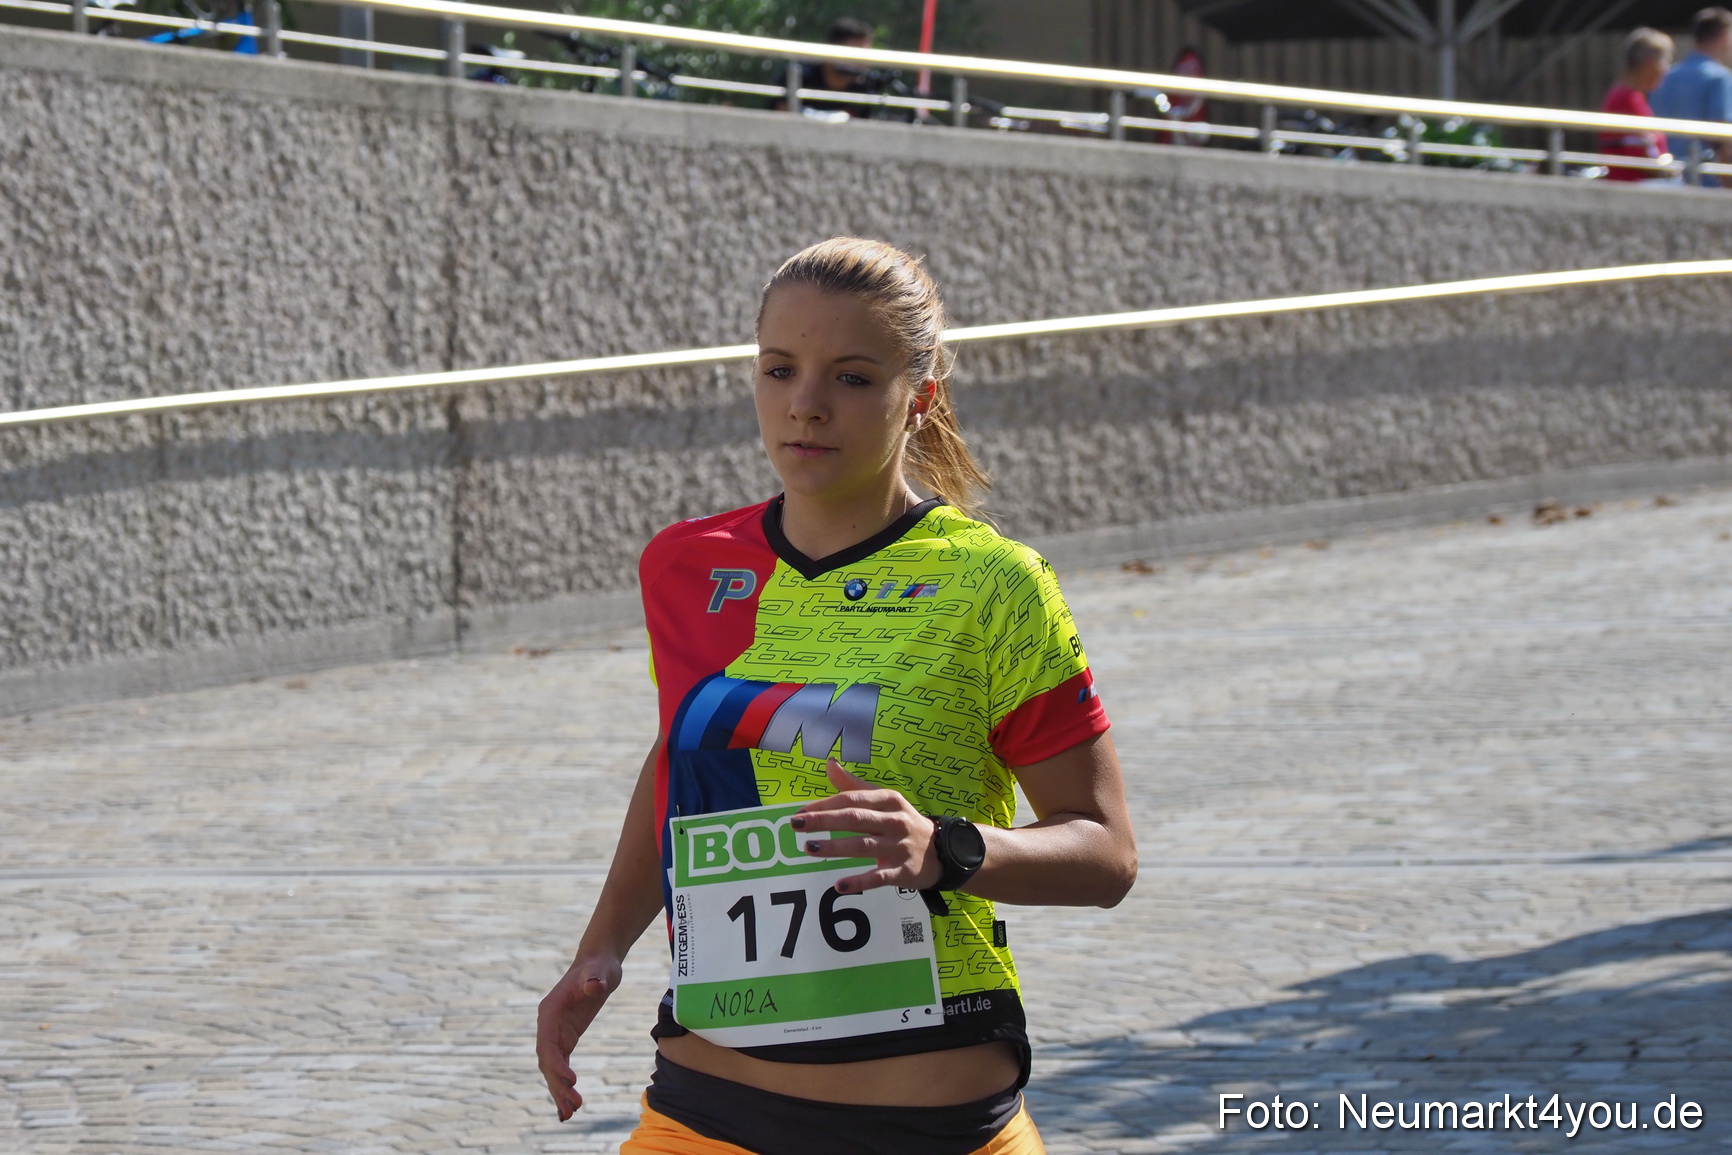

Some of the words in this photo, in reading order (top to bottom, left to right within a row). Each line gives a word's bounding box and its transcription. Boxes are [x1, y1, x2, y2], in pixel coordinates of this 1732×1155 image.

[877, 704, 994, 755] turb
[726, 886, 872, 962] 176
[710, 988, 778, 1020] NORA
[944, 995, 992, 1016] artl.de
